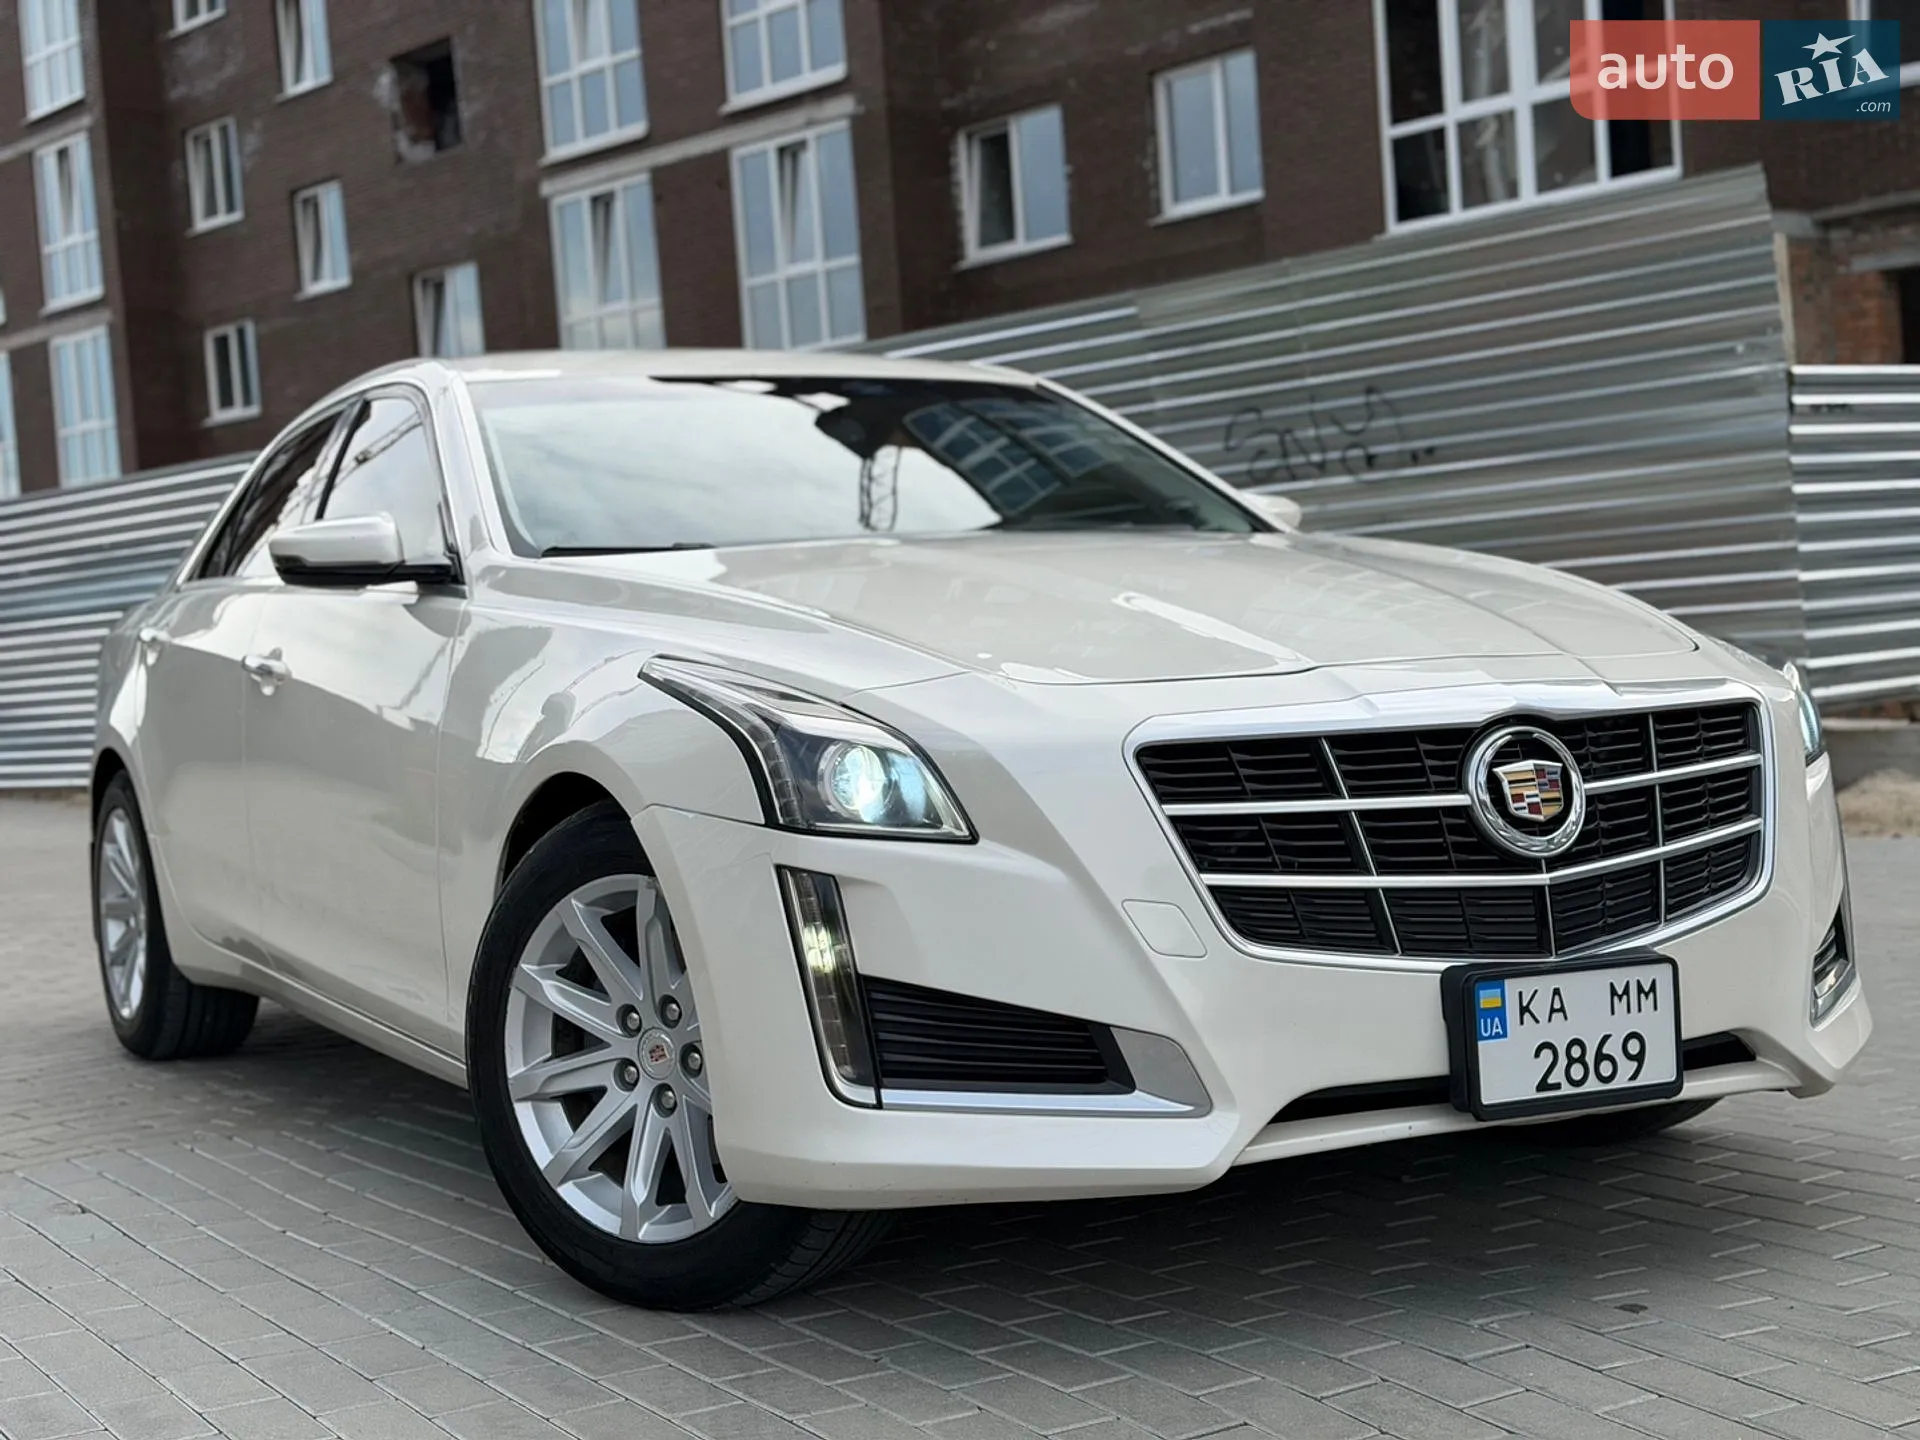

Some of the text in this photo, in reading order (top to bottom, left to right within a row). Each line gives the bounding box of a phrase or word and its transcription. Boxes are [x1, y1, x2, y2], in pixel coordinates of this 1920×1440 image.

[1518, 978, 1658, 1026] KA MM
[1481, 1017, 1503, 1037] UA
[1534, 1031, 1646, 1093] 2869
